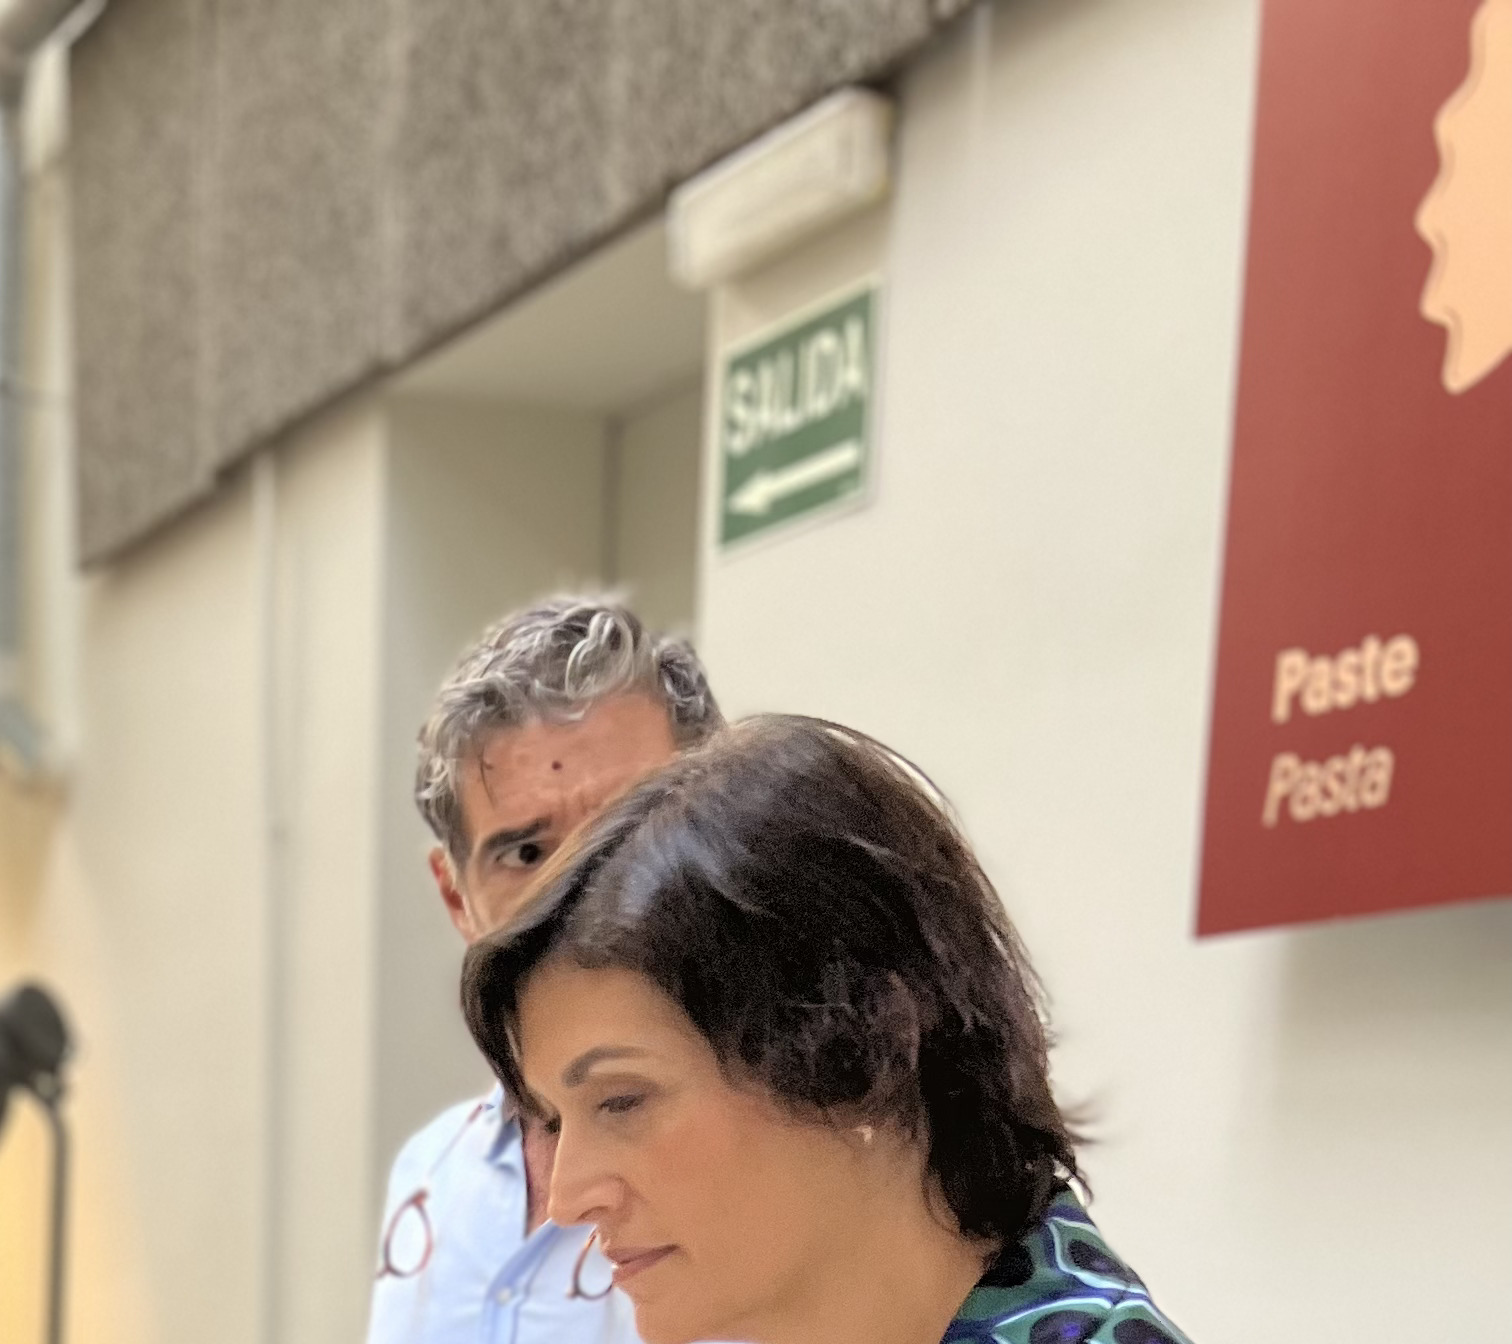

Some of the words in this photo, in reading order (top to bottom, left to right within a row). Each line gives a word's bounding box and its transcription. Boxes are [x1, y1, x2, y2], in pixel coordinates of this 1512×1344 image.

[726, 315, 865, 456] SALIDA
[1272, 633, 1420, 724] Paste
[1262, 743, 1394, 828] Pasta
